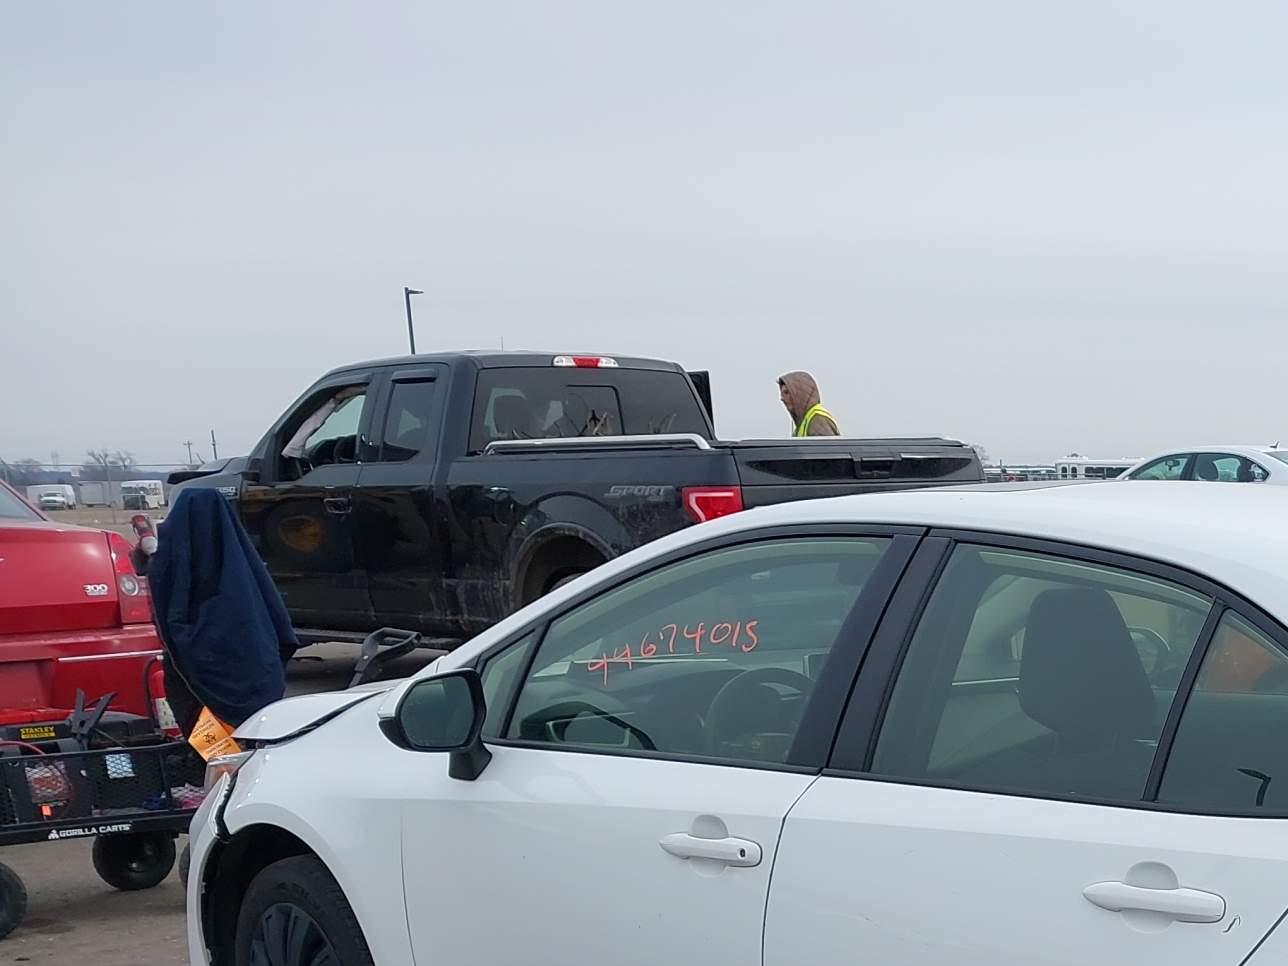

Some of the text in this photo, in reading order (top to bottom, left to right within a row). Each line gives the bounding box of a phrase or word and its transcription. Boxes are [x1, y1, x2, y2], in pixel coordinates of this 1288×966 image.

[604, 485, 673, 501] SPORT
[83, 584, 108, 593] 300
[587, 620, 759, 687] 44674015
[20, 726, 54, 735] STANLEY
[60, 824, 131, 837] GORILLA CARTS
